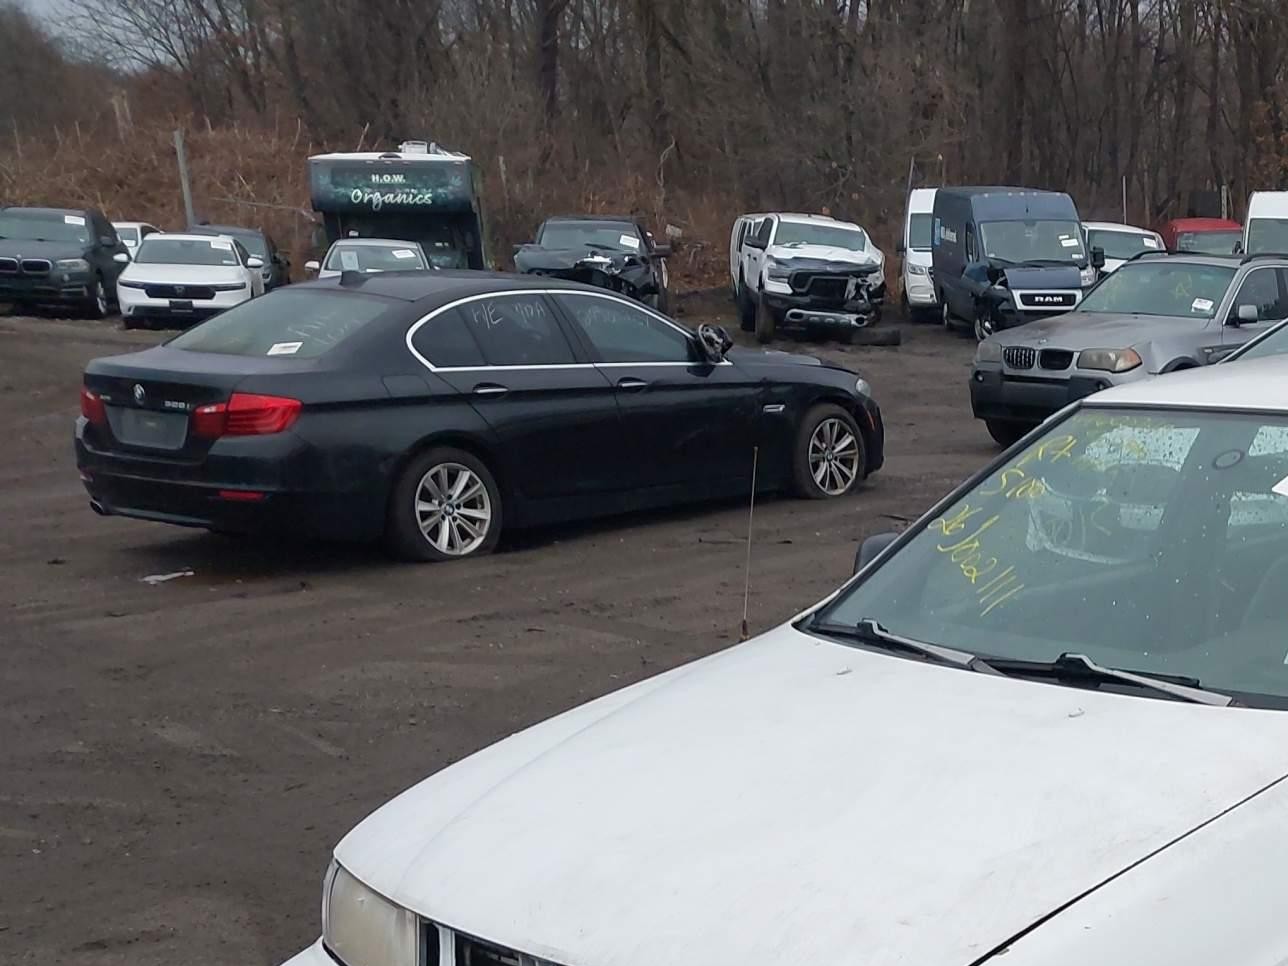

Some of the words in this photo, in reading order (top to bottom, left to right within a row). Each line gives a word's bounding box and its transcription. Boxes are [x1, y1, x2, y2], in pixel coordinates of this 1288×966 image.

[371, 174, 406, 184] H.O.W.
[351, 189, 433, 211] Organics
[1034, 295, 1063, 303] RAM
